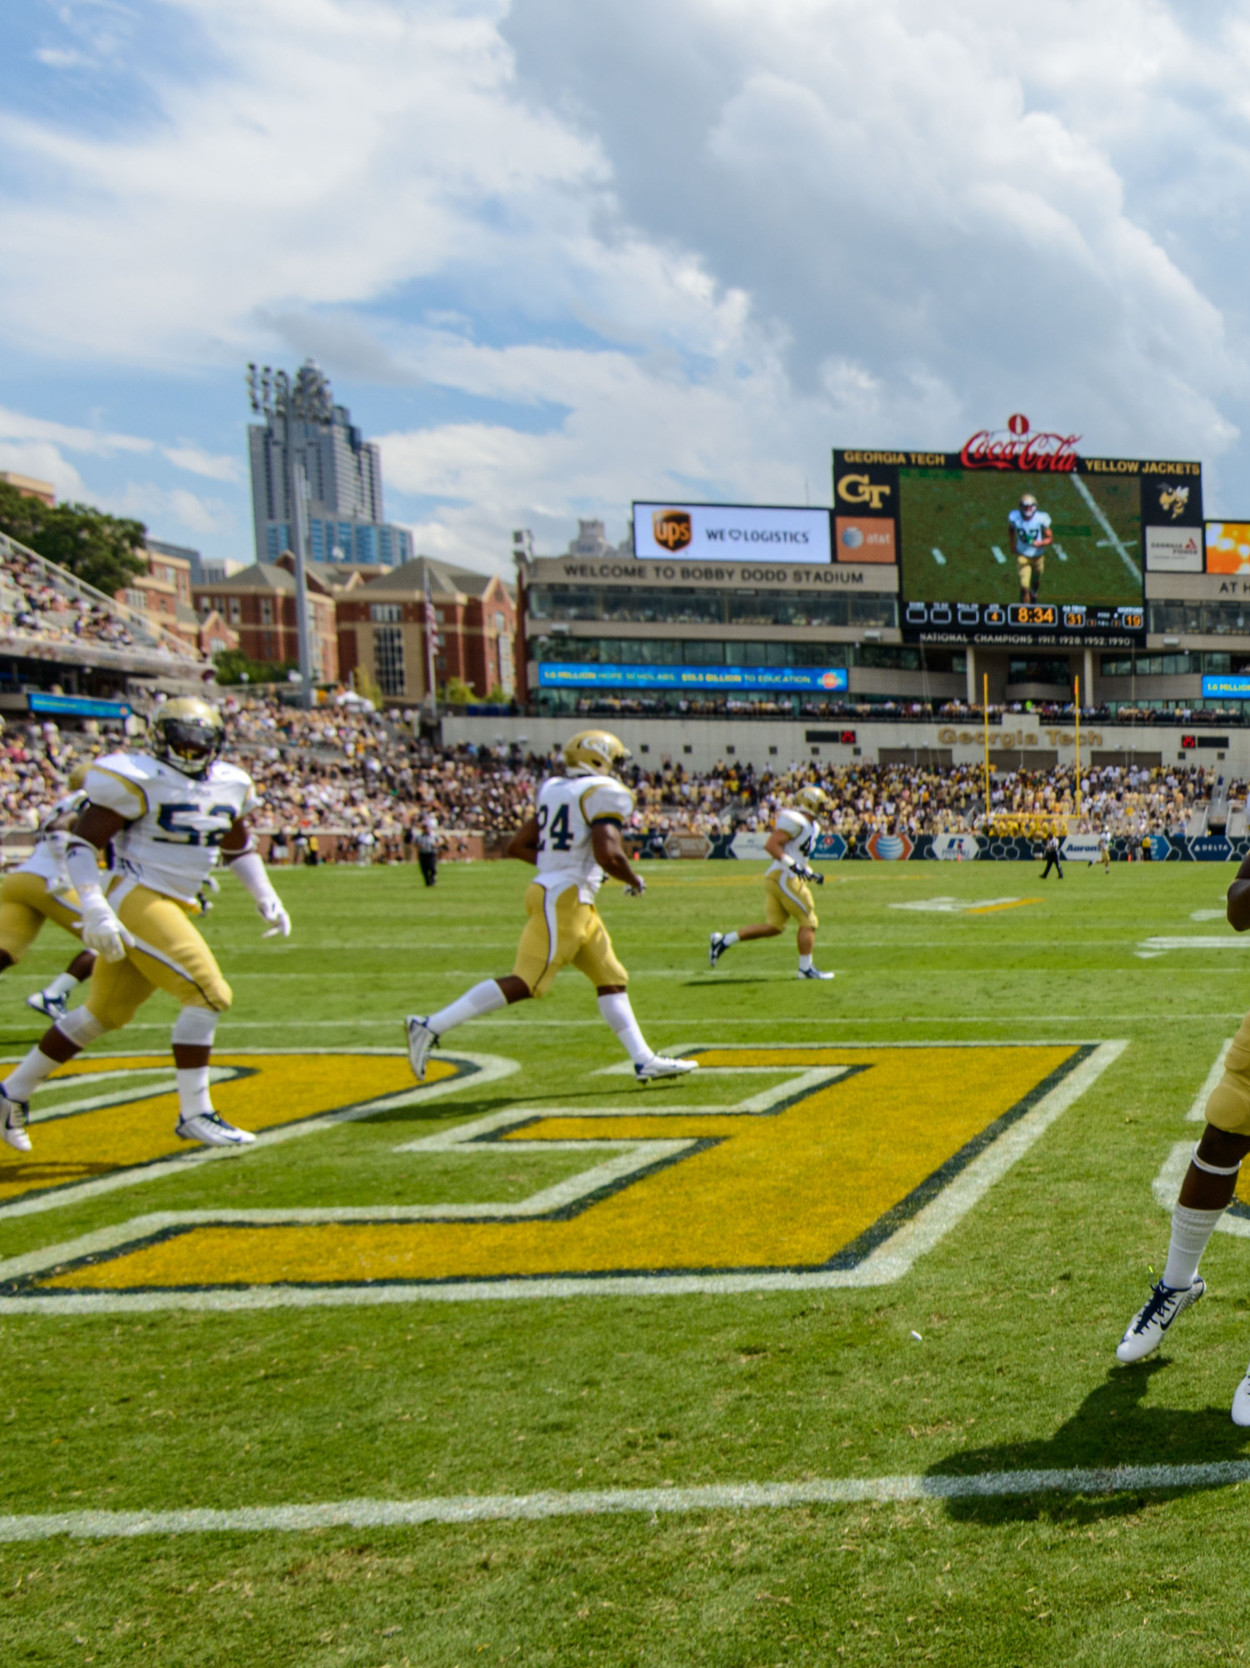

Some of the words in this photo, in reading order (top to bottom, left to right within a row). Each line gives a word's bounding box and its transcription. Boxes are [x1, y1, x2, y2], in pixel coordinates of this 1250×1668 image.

[844, 451, 906, 464] GEORGIA
[910, 453, 946, 466] TECH
[960, 430, 1082, 471] Coca-Cola
[1085, 459, 1138, 473] YELLOW
[1141, 461, 1201, 475] JACKETS
[837, 474, 891, 509] GT
[655, 520, 690, 547] ups
[705, 528, 725, 541] WE
[743, 530, 809, 544] LOGISTICS
[564, 564, 648, 579] WELCOME
[653, 566, 675, 580] TO
[680, 567, 735, 582] BOBBY
[741, 570, 787, 583] DODD
[793, 571, 864, 584] STADIUM
[1219, 581, 1237, 594] AT
[991, 611, 998, 622] 4
[1018, 607, 1054, 623] 8:34
[1067, 612, 1082, 625] 31
[920, 632, 968, 642] NATIONAL
[974, 633, 1033, 645] CHAMPIONS
[1109, 638, 1131, 646] 1990
[937, 727, 1038, 748] Georgia
[1045, 729, 1103, 746] Tech
[537, 804, 574, 852] 24
[1201, 844, 1229, 852] DELTA
